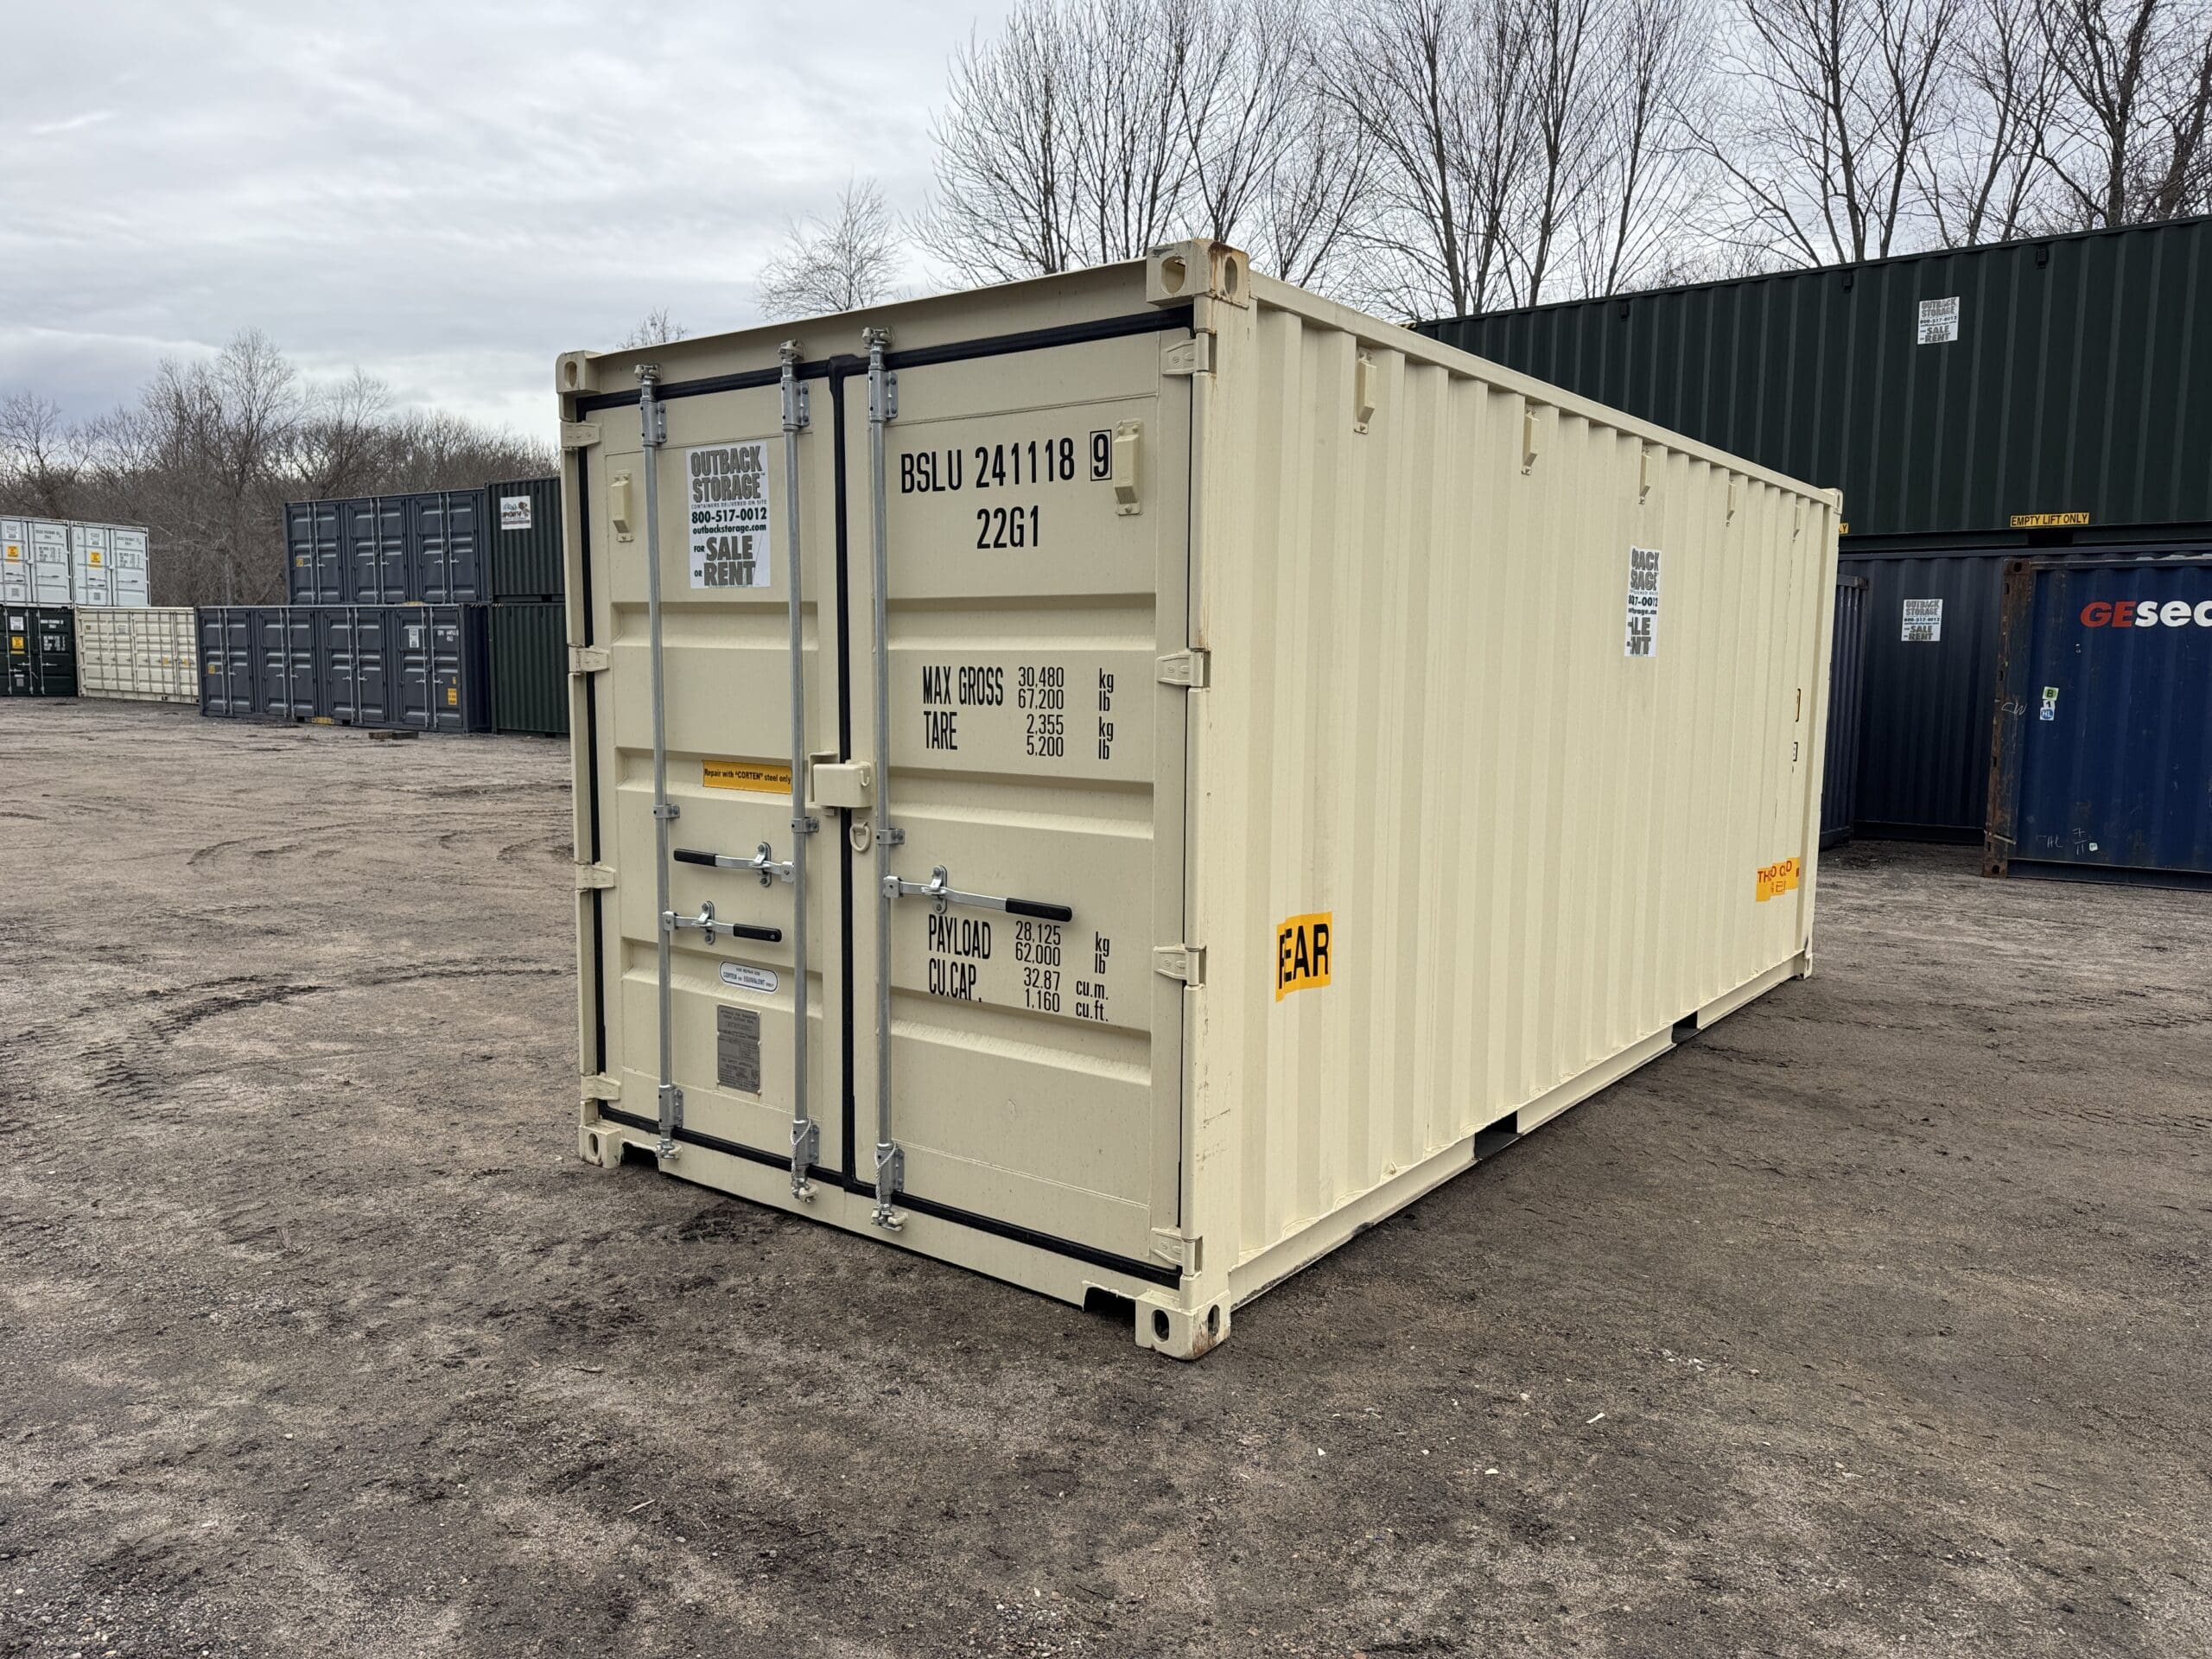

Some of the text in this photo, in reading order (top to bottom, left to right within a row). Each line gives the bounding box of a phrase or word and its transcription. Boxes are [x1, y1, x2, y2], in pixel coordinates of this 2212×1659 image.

[1925, 333, 1950, 342] RENT
[1927, 325, 1949, 334] SALE
[691, 445, 763, 478] OUTBACK
[901, 432, 1109, 493] BSLU 241118 9
[692, 473, 761, 503] STORAGE
[691, 507, 767, 524] 800-517-0012
[976, 505, 1039, 549] 22G1
[2012, 513, 2088, 525] EMPTY LIFT ONLY
[693, 524, 767, 534] outbackstorage.com
[706, 535, 753, 562] SALE
[703, 561, 756, 586] RENT
[1910, 625, 1933, 633] SALE
[923, 665, 1114, 706] MAX GROSS 30,480 kg
[1018, 689, 1110, 711] 67,200 lb
[924, 710, 1114, 750] TARE 2,355 kg
[1027, 735, 1110, 760] 5,200 lb
[704, 768, 721, 778] Repair
[722, 769, 734, 778] with
[779, 774, 791, 785] only
[928, 913, 1110, 960] PAYLOAD 28,125 kg
[1015, 942, 1106, 975] 62,000 lb
[1023, 967, 1061, 991] 32.87
[1076, 980, 1109, 1000] cu.m.
[1075, 1000, 1109, 1021] cu.ft.
